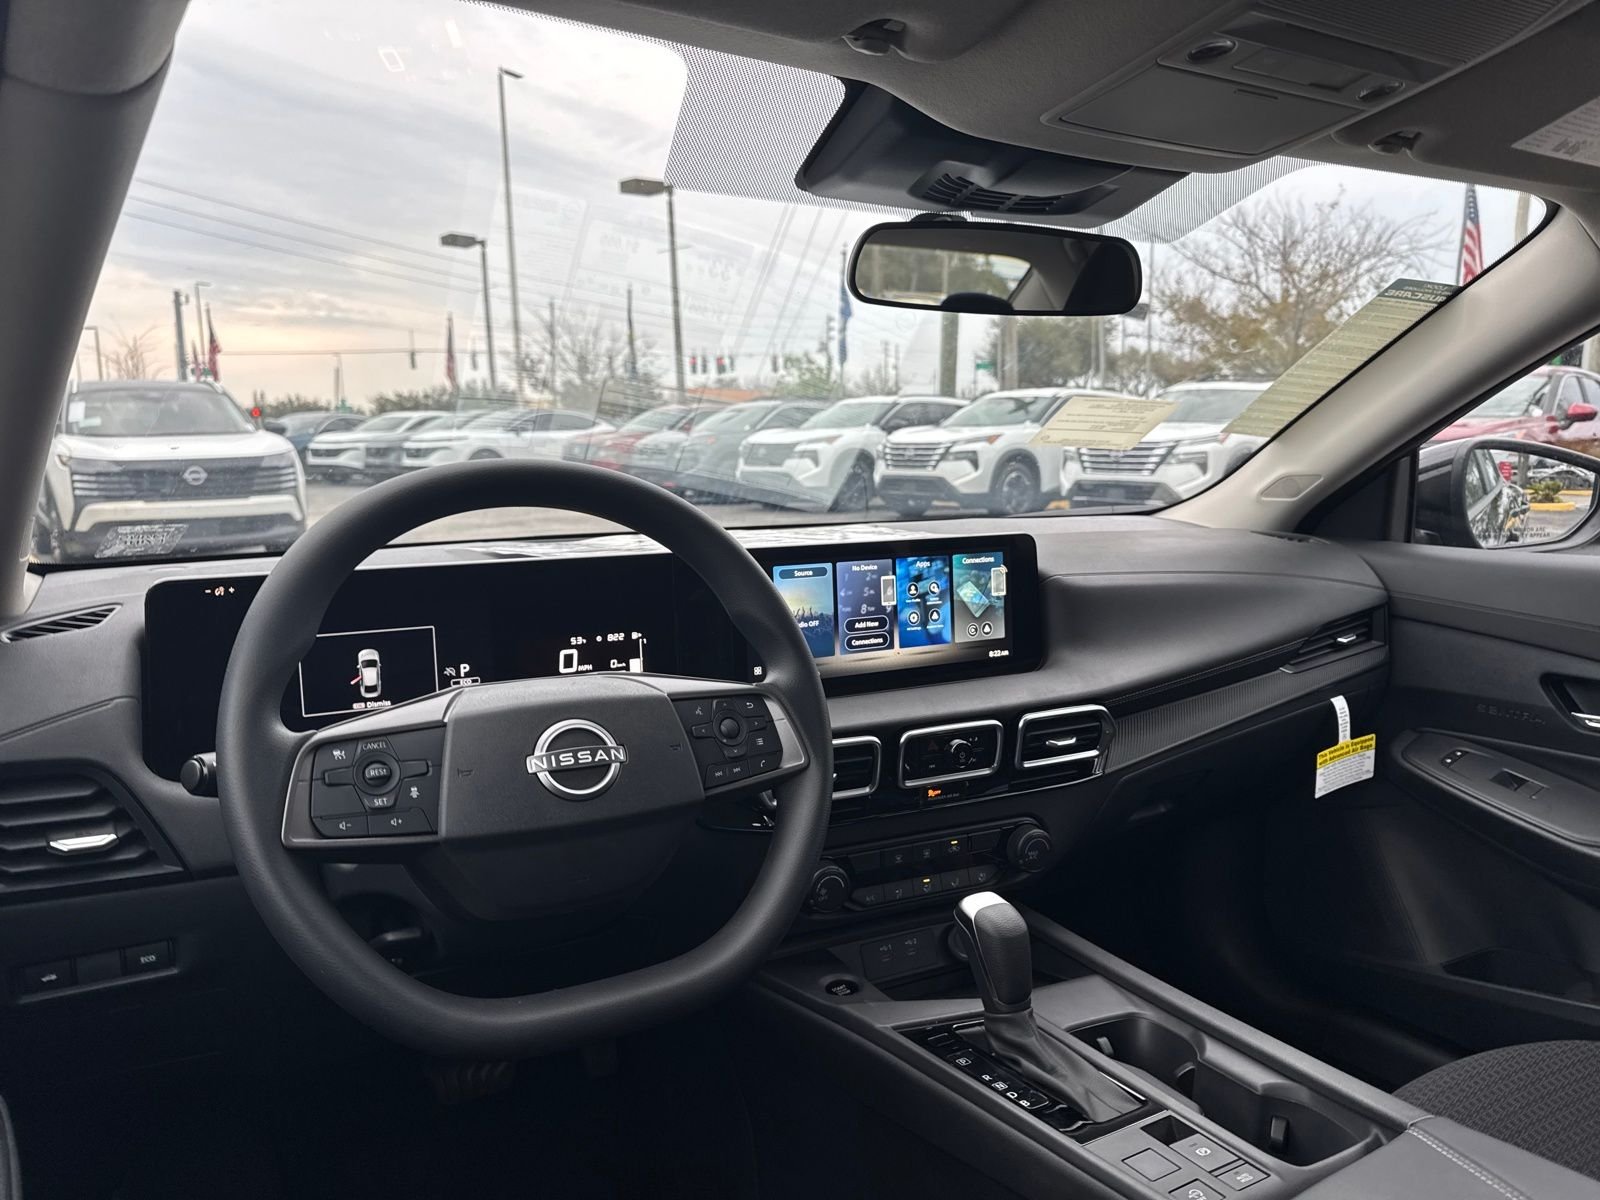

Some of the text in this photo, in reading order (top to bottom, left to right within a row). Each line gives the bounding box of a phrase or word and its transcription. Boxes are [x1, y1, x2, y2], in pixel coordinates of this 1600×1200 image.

[916, 560, 931, 569] Apps
[962, 555, 995, 565] Connections
[854, 620, 879, 629] Add New
[851, 637, 884, 646] Connections
[559, 648, 578, 674] 0
[459, 663, 470, 678] P
[366, 699, 392, 709] Dismiss
[362, 741, 387, 751] CANCEL
[529, 747, 626, 772] NISSAN
[373, 797, 388, 807] SET
[1006, 1091, 1018, 1099] D
